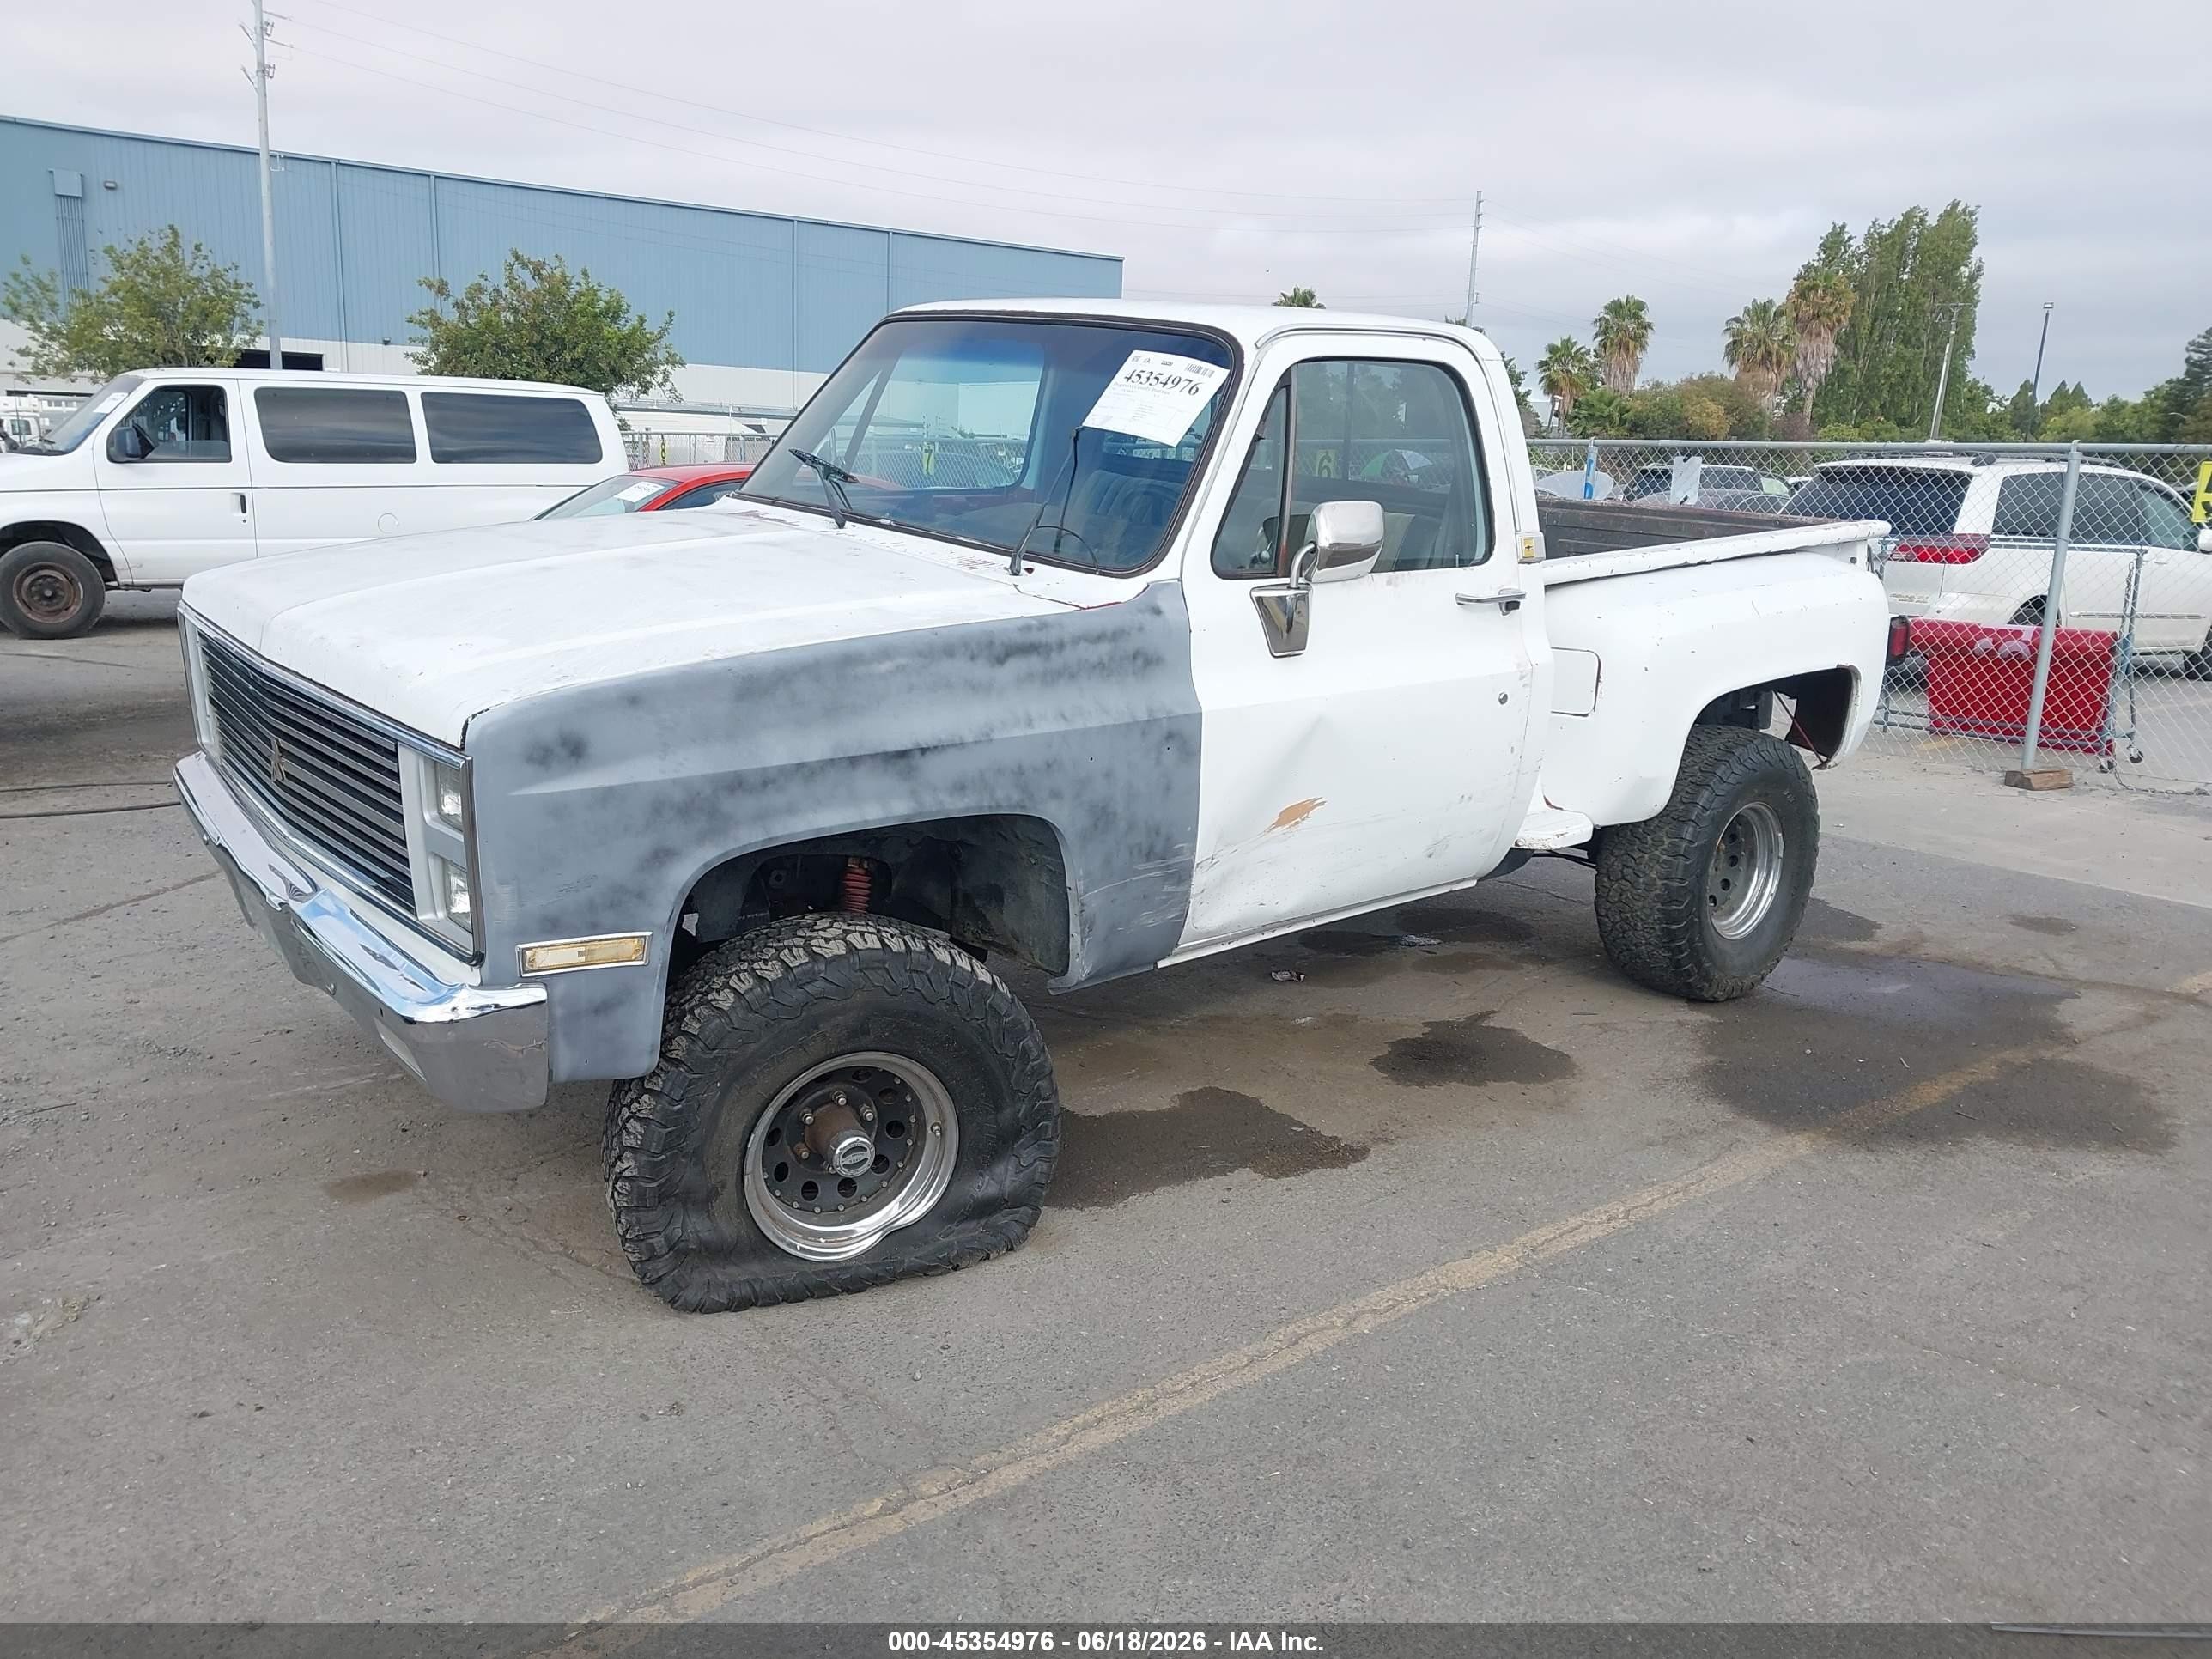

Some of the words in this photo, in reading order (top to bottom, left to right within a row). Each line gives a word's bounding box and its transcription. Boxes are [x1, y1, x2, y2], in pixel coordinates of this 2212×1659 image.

[1124, 368, 1203, 396] 45354976
[923, 447, 933, 472] 7
[1317, 453, 1333, 478] 6
